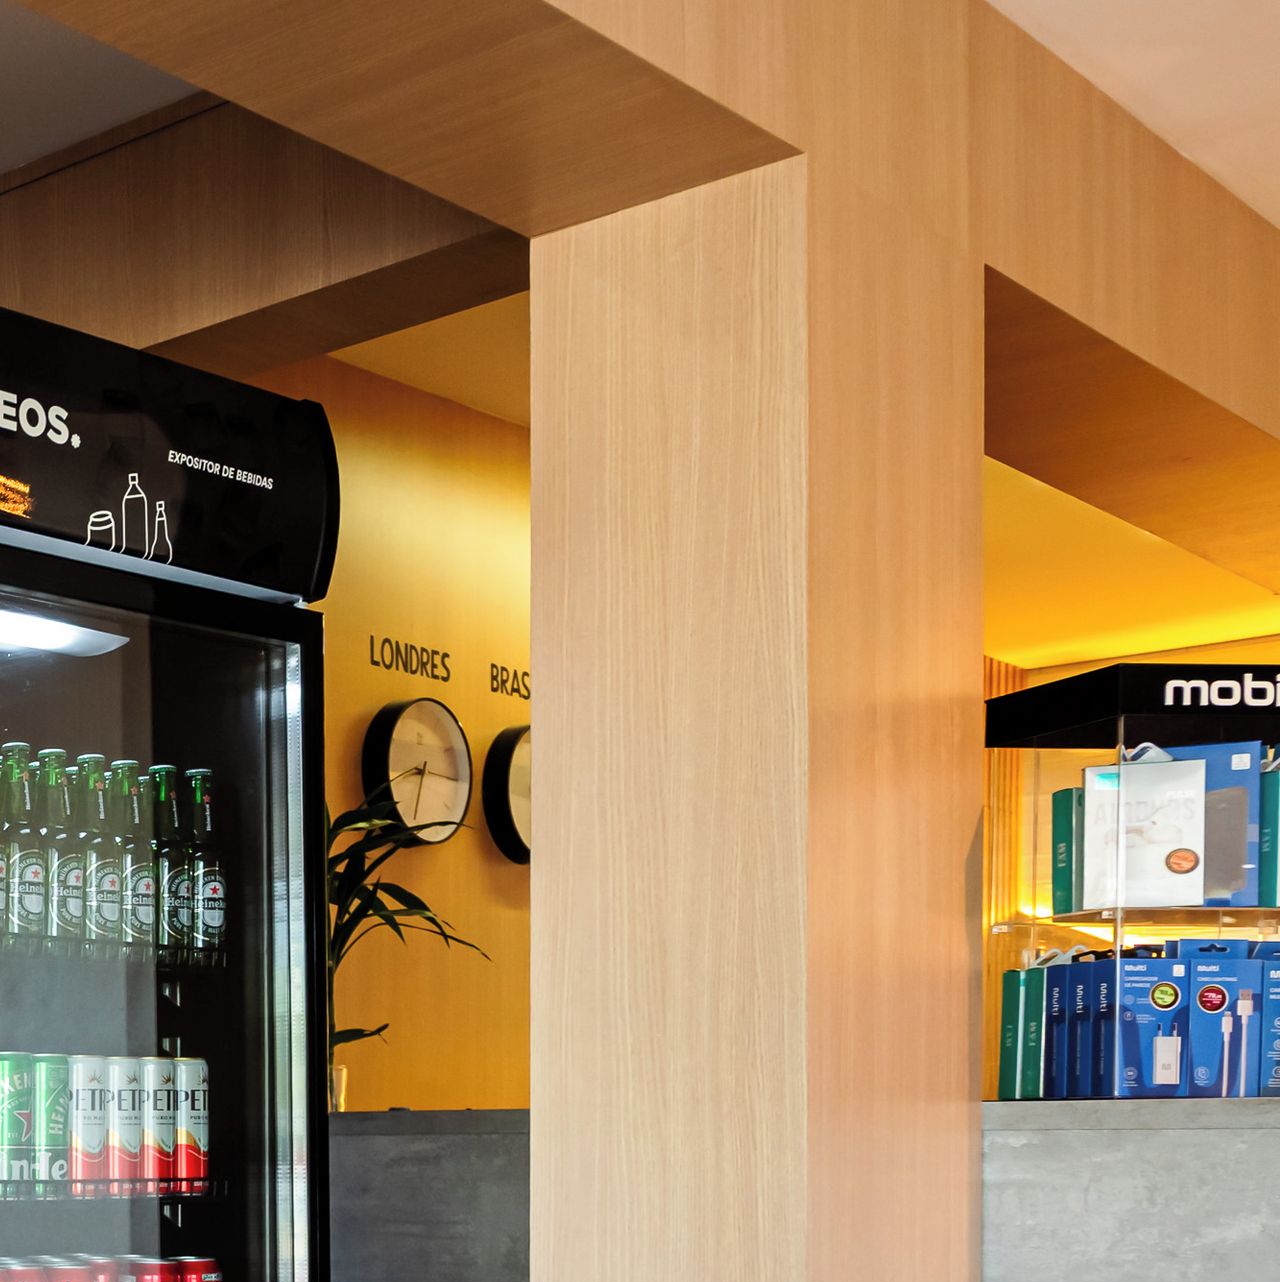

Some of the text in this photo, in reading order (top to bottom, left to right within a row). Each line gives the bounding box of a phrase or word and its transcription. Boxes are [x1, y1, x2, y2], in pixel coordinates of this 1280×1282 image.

[167, 449, 274, 490] EXPOSITOR DE BEBIDAS
[369, 635, 451, 683] LONDRES
[1052, 987, 1060, 1016] Multi
[1076, 985, 1084, 1014] Multi
[1100, 983, 1108, 1012] Multi
